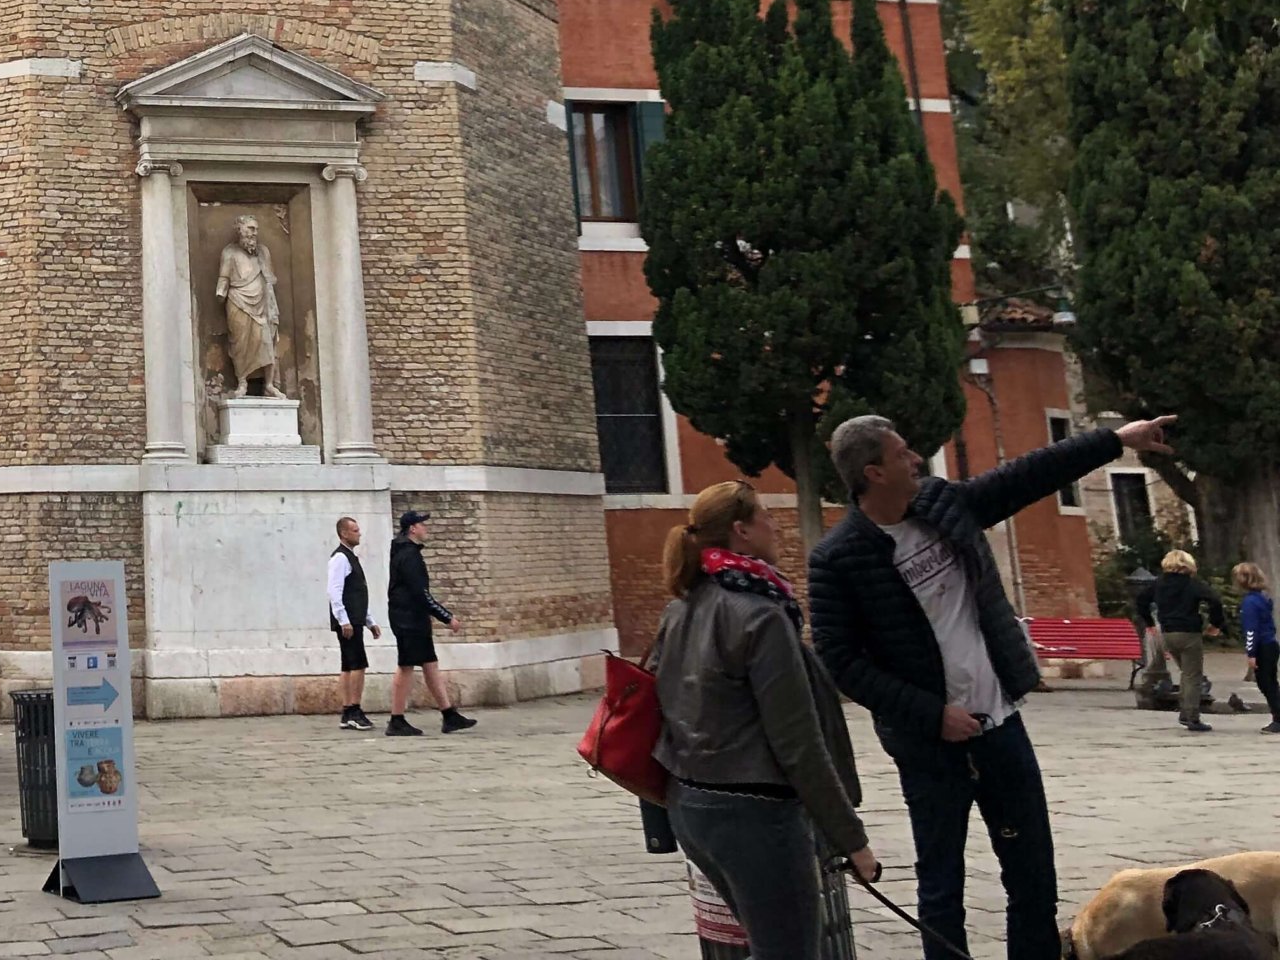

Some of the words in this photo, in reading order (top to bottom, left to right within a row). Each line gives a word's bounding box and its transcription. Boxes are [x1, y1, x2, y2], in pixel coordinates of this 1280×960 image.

[69, 580, 107, 591] LAGUNA
[90, 587, 110, 598] VITA
[72, 730, 99, 739] VIVERE
[70, 739, 85, 747] TRA
